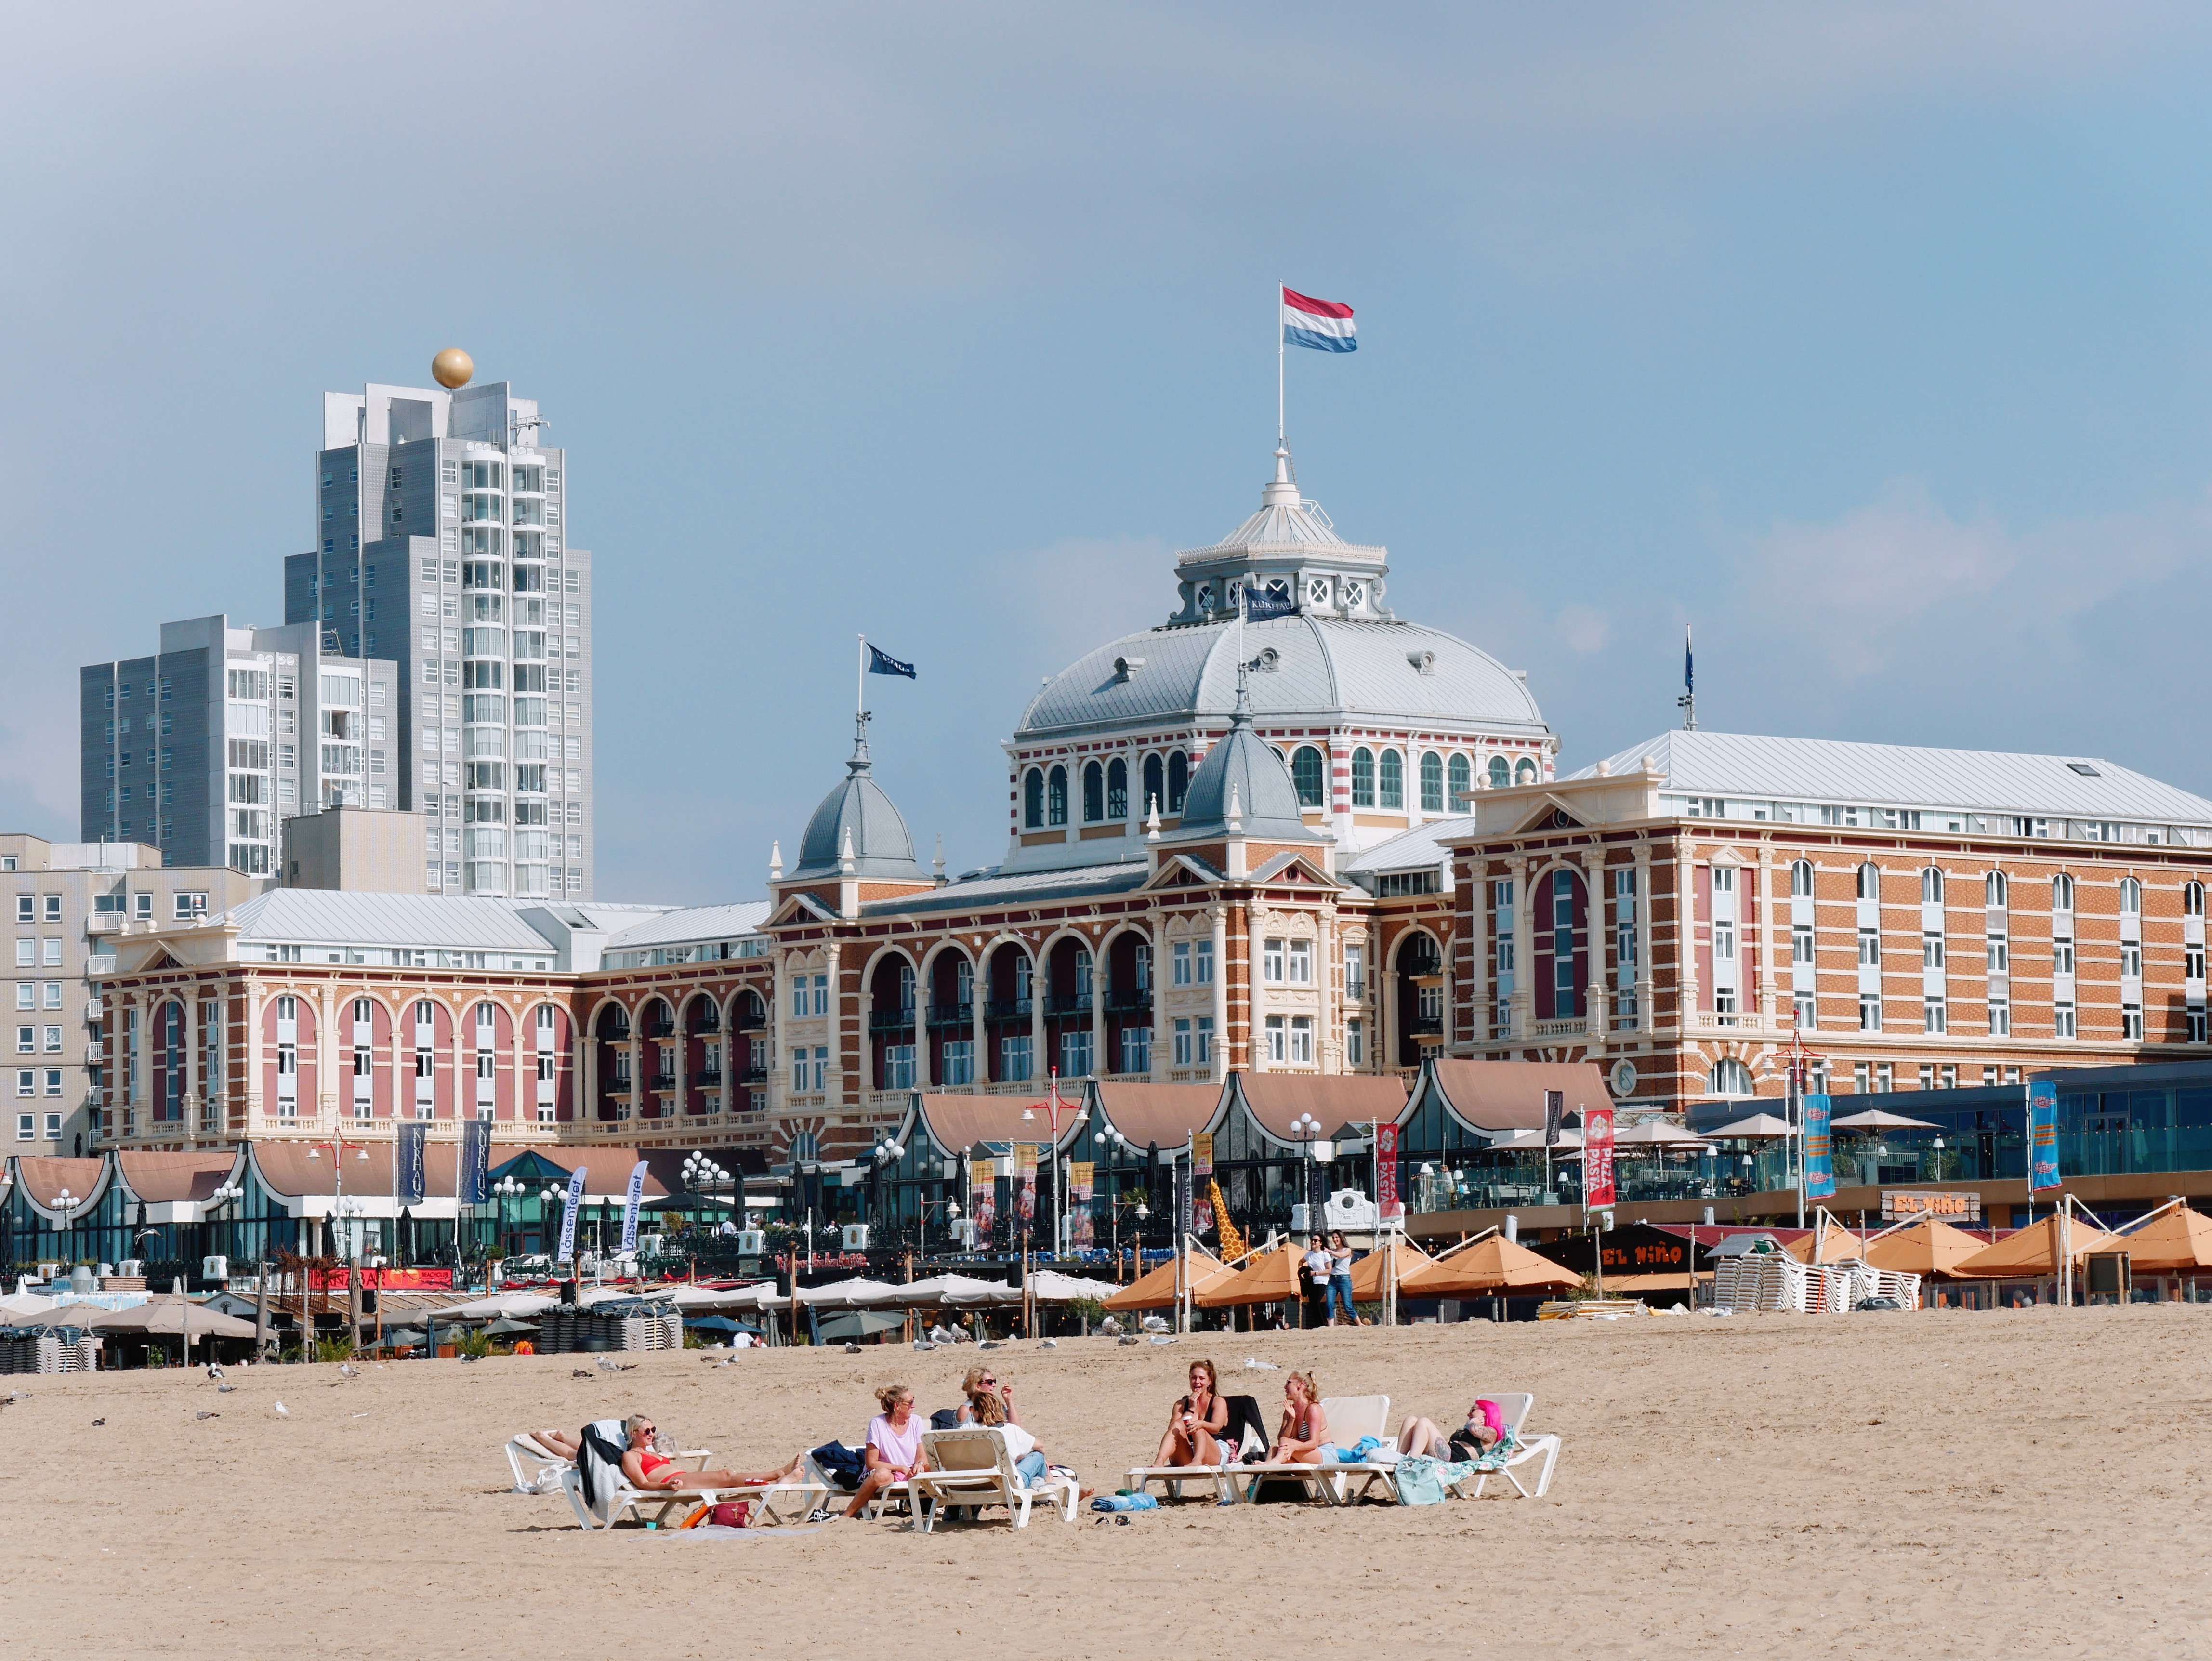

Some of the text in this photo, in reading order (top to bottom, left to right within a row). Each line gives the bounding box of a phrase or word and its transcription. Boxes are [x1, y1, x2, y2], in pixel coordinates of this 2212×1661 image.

[412, 1128, 422, 1202] KURHAUS
[477, 1125, 487, 1200] KURHAUS
[1379, 1162, 1390, 1203] PASTA
[1589, 1149, 1600, 1193] PASTA
[1601, 1148, 1612, 1188] PIZZA
[561, 1180, 581, 1254] Låssenteret
[1894, 1196, 1918, 1213] EL
[1602, 1248, 1627, 1265] EL
